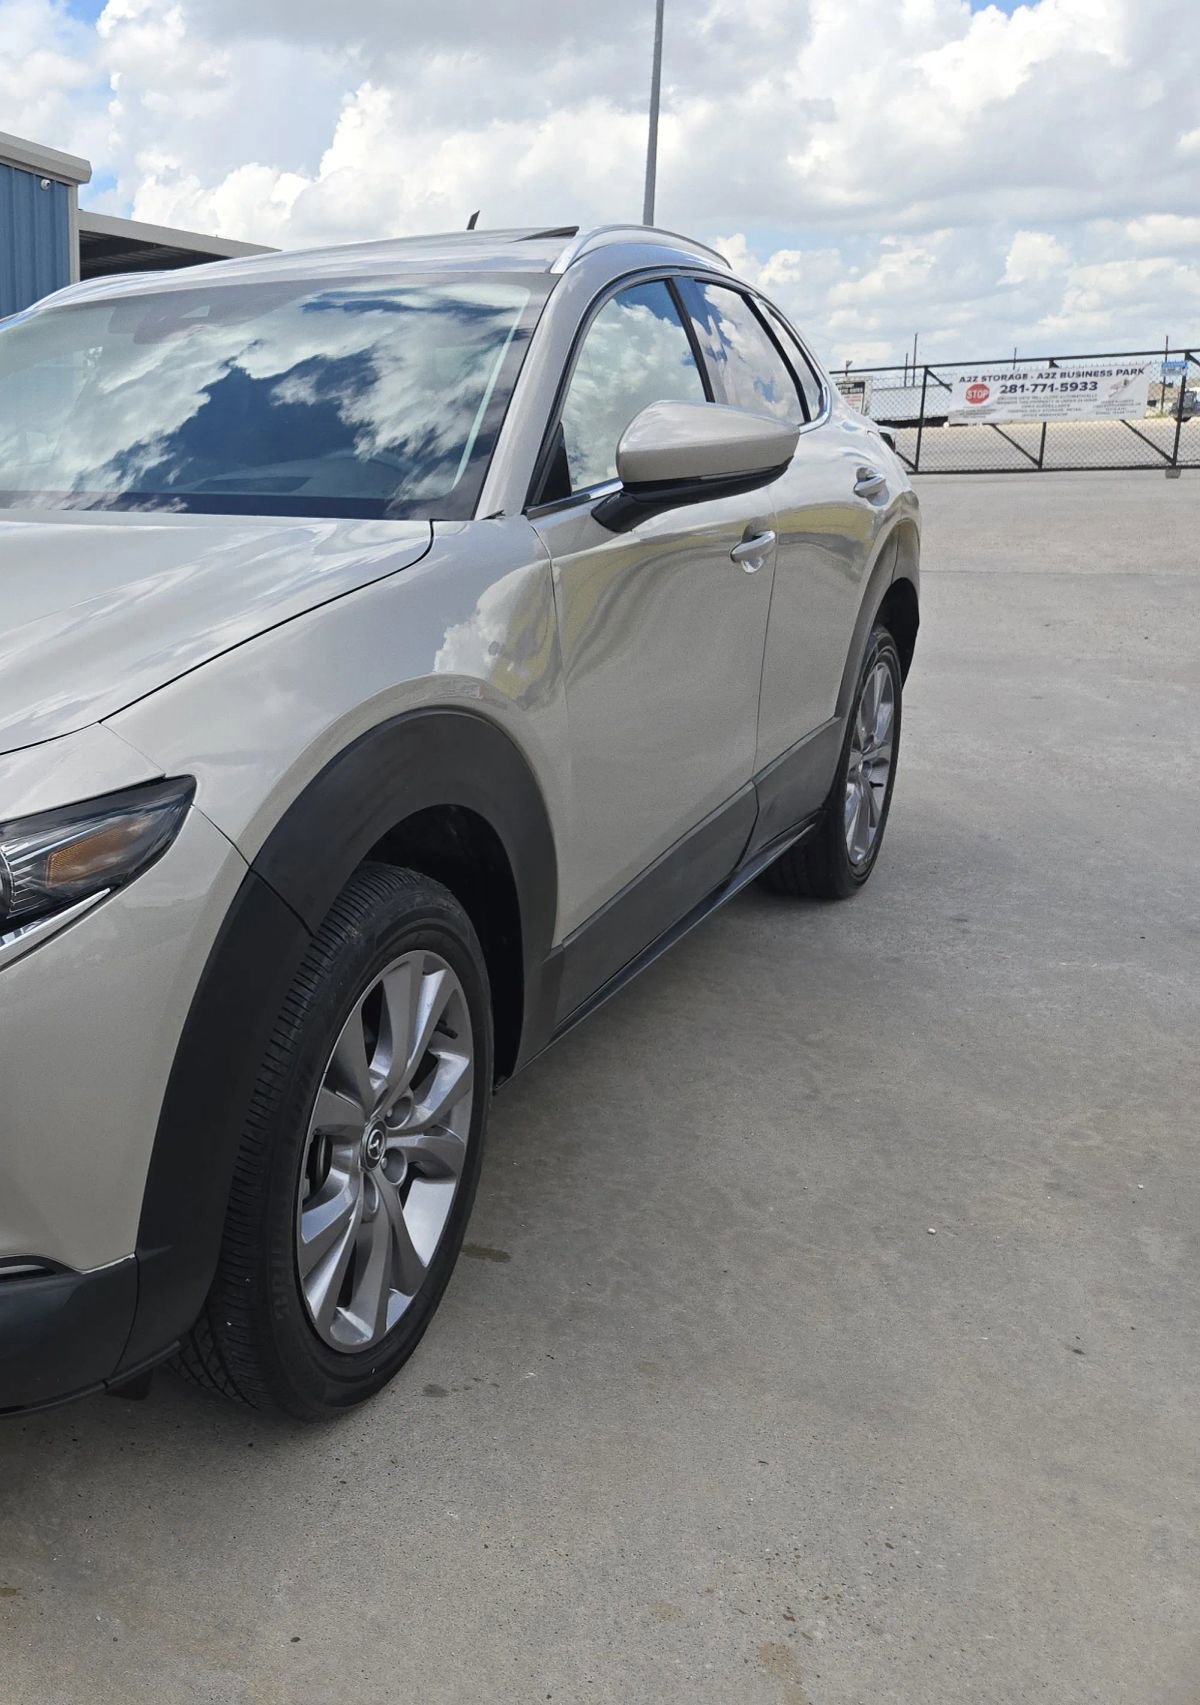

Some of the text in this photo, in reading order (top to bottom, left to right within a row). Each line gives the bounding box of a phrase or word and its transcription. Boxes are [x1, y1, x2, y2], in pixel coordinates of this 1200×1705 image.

[959, 375, 979, 383] A2Z
[981, 373, 1028, 382] STORAGE
[1036, 371, 1057, 380] A2Z
[1060, 369, 1113, 378] BUSINESS
[1116, 367, 1145, 376] PARK
[999, 381, 1098, 394] 281-771-5933
[966, 389, 989, 400] STOP
